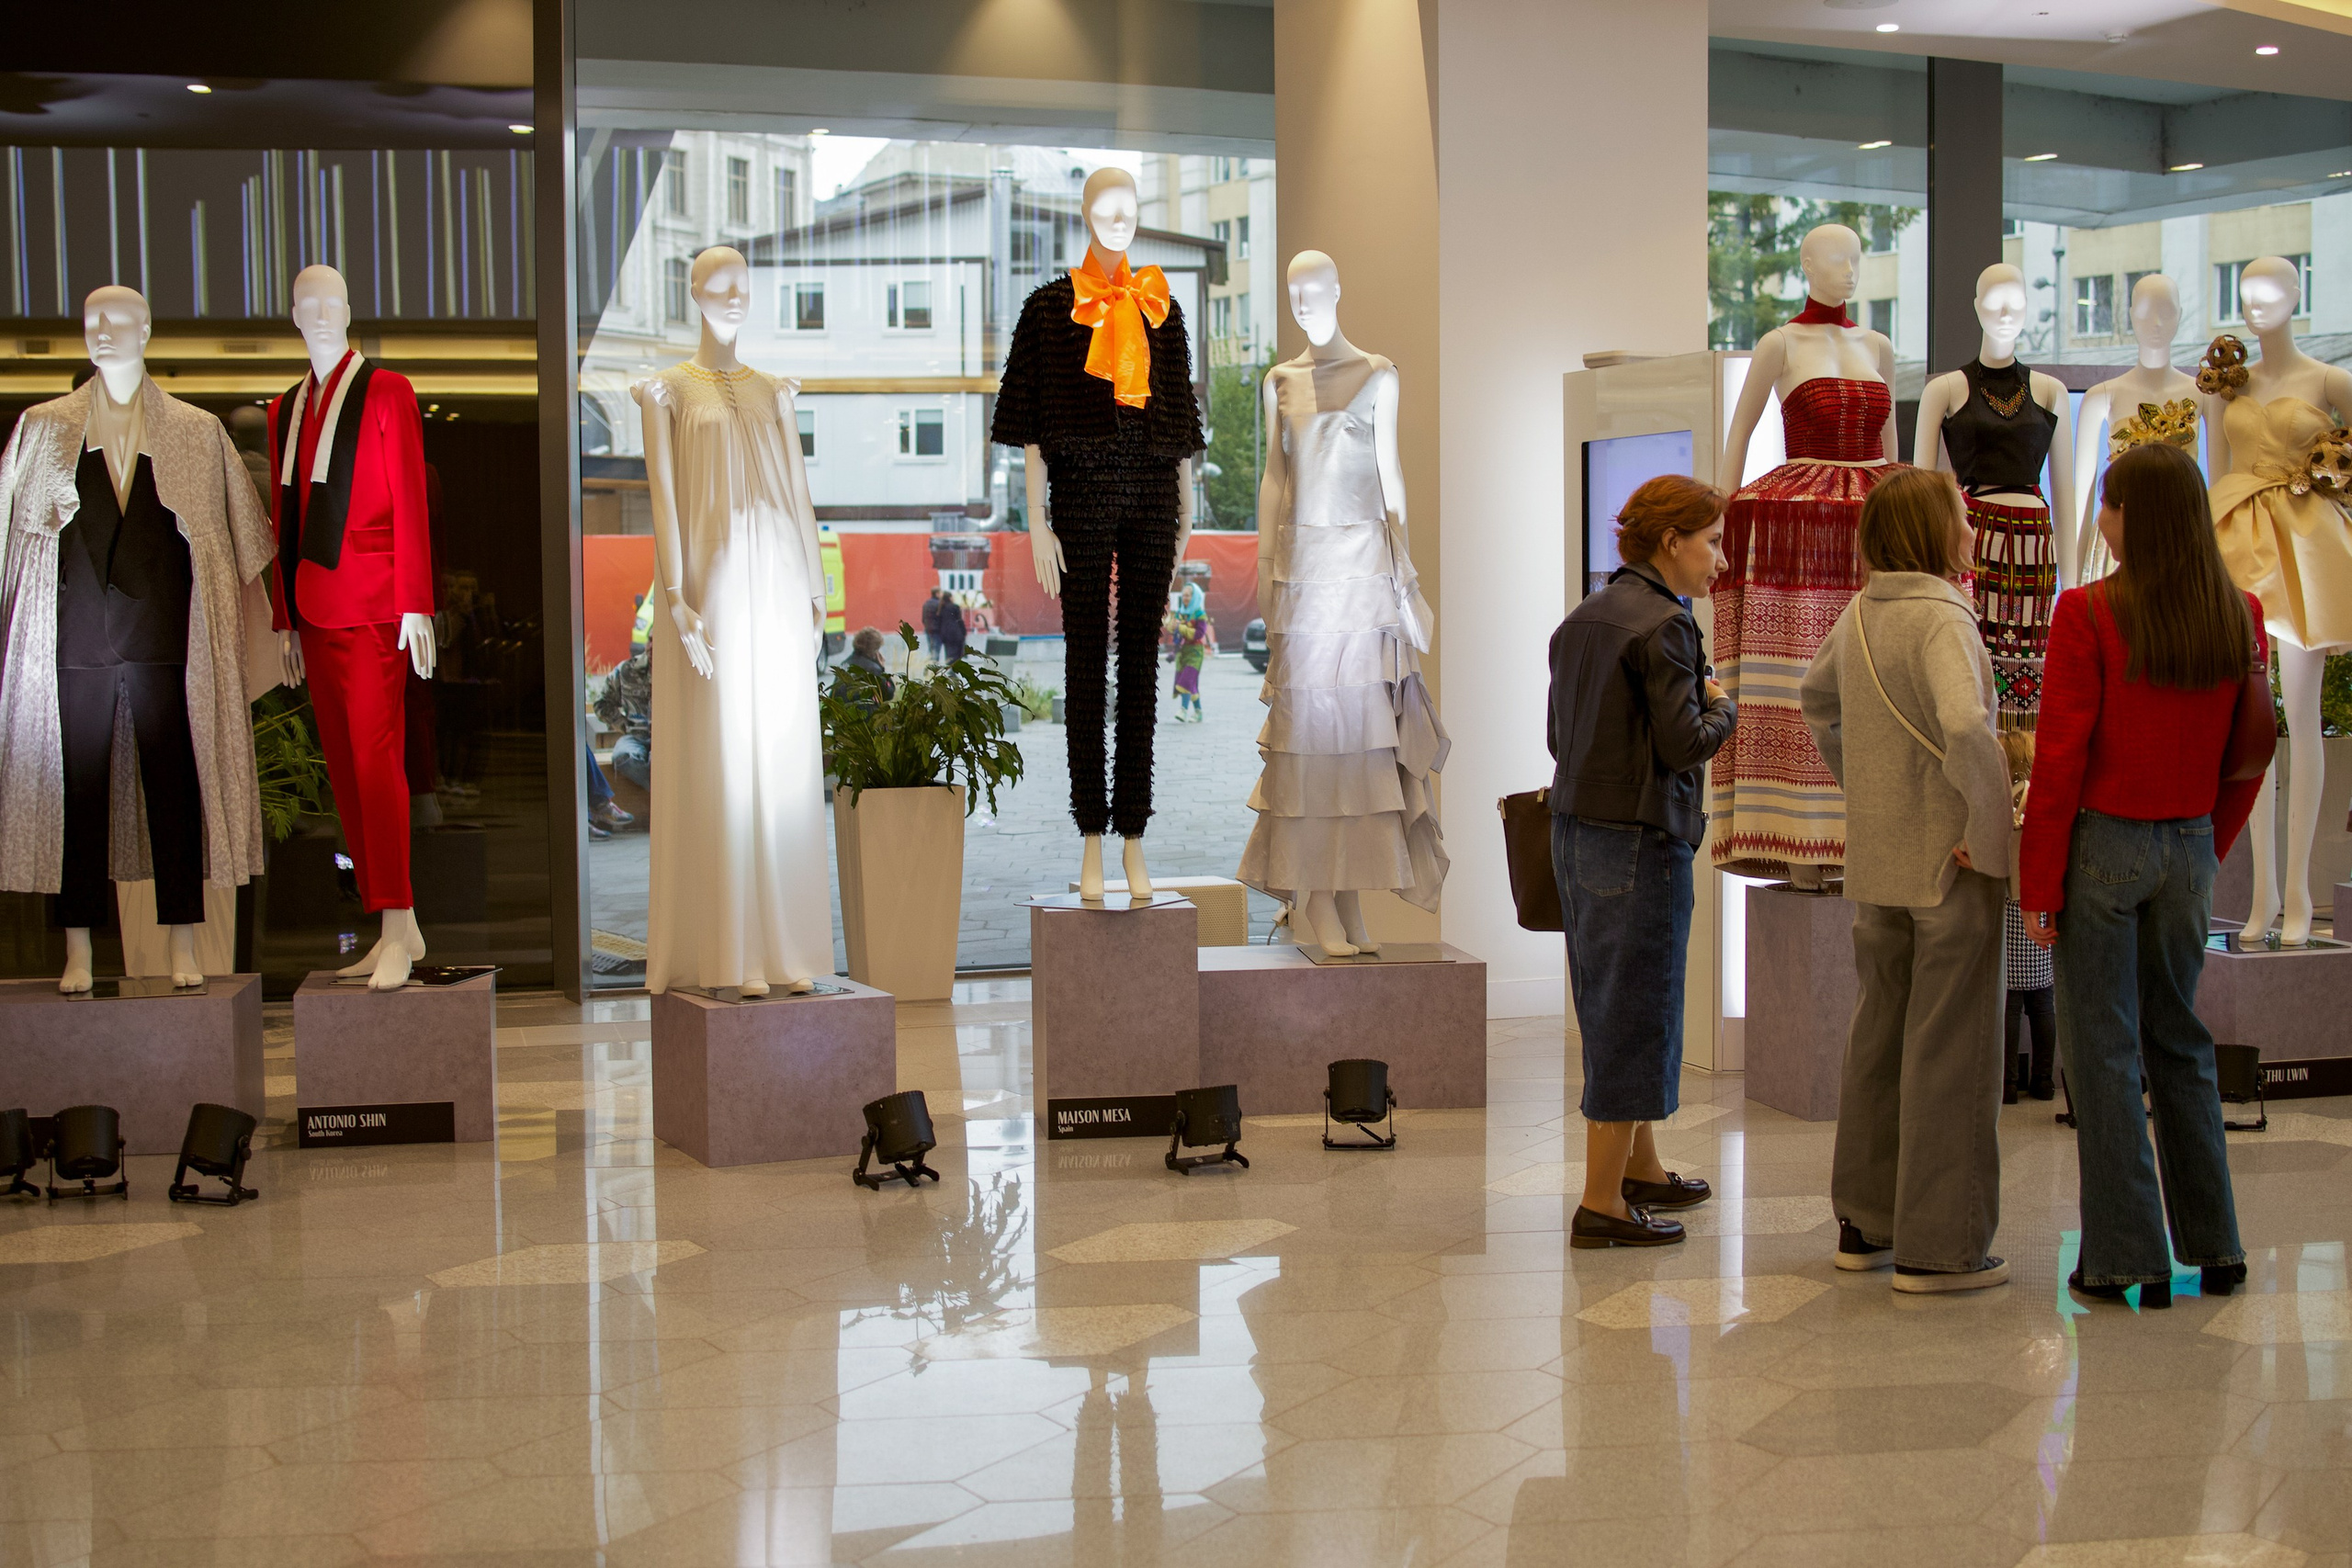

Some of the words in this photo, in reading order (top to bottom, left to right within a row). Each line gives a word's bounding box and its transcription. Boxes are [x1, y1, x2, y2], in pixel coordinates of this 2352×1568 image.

[2266, 1069, 2285, 1083] THU
[2287, 1067, 2309, 1081] LWIN
[307, 1114, 356, 1130] ANTONIO
[359, 1112, 387, 1128] SHIN
[1057, 1110, 1100, 1124] MAISON
[1102, 1108, 1131, 1122] MESA
[308, 1130, 324, 1138] South
[325, 1129, 344, 1137] Korea
[1057, 1125, 1074, 1134] Spain
